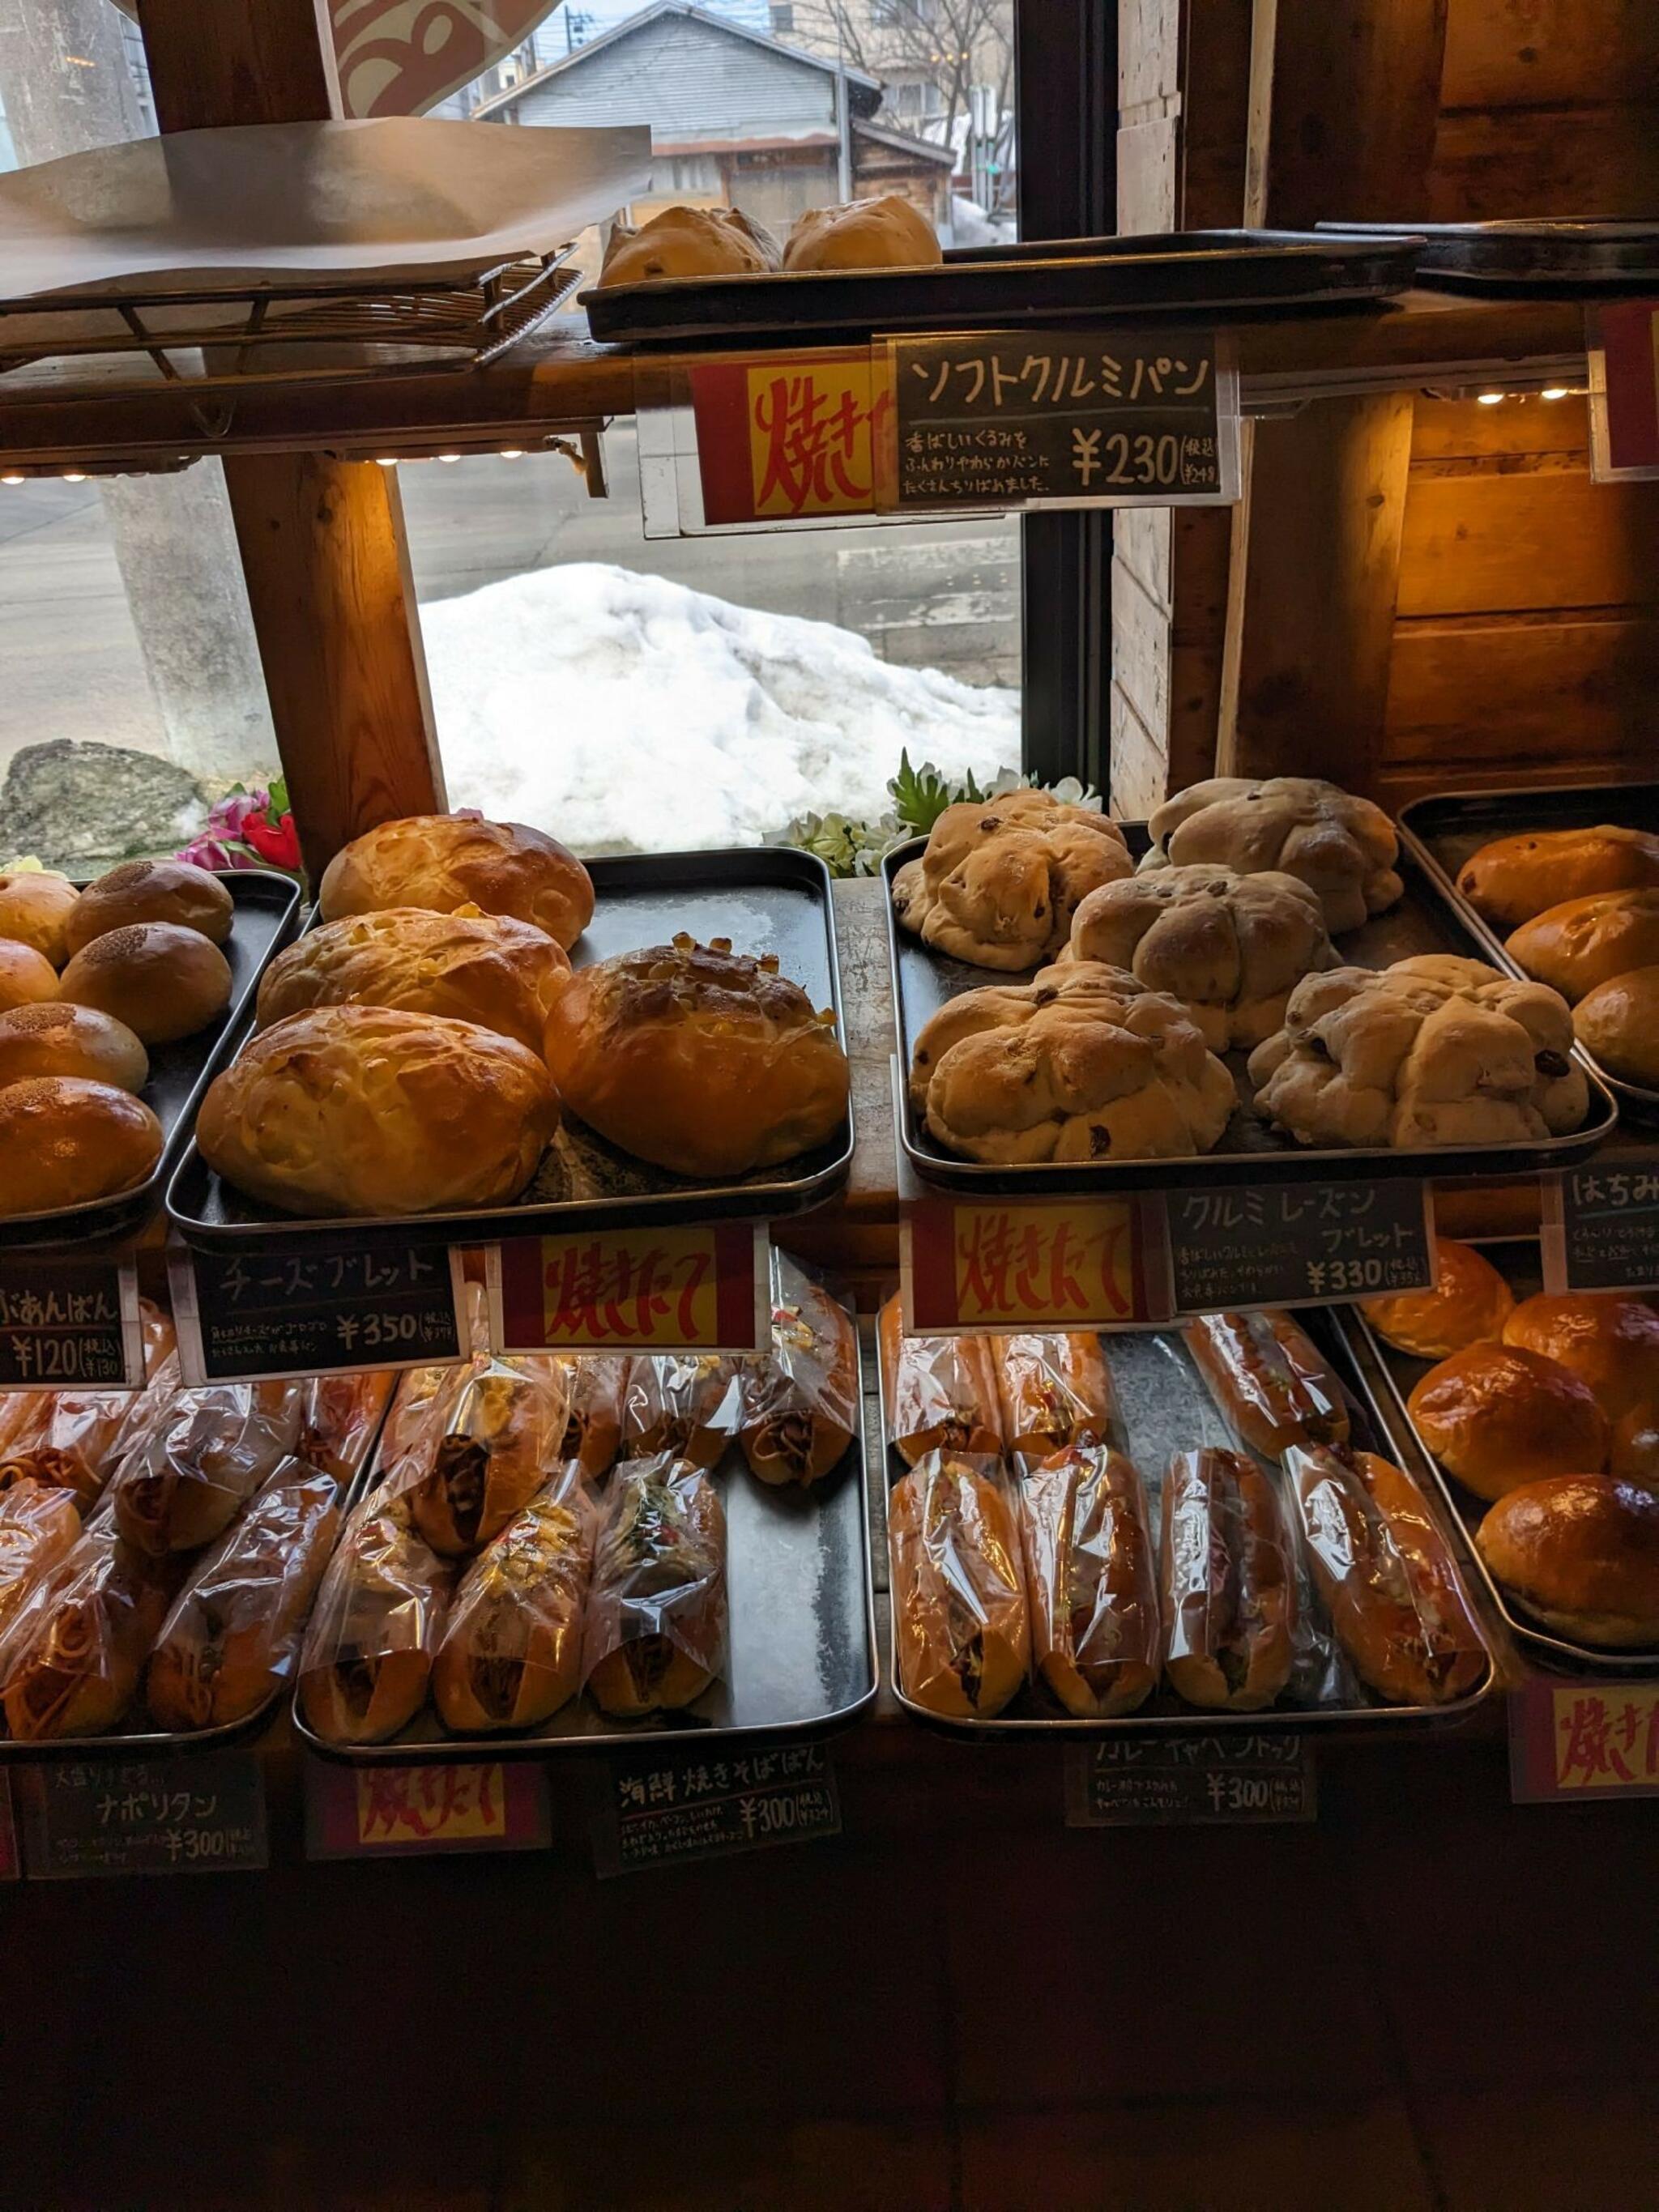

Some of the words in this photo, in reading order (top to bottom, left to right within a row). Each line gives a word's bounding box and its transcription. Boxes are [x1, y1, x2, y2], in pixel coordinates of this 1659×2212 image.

[911, 355, 1210, 407] ソフトクルミパン
[1072, 427, 1179, 486] ¥230
[1320, 1221, 1414, 1253] ブレット
[957, 1213, 1132, 1315] 焼きたて
[1307, 1258, 1383, 1295] ¥330
[544, 1241, 711, 1340] 焼きたて
[336, 1312, 417, 1350] ¥350
[11, 1334, 78, 1378] ¥120
[96, 1791, 217, 1824] ナポリタン
[1206, 1773, 1269, 1813] ¥300
[738, 1796, 795, 1839] ¥300
